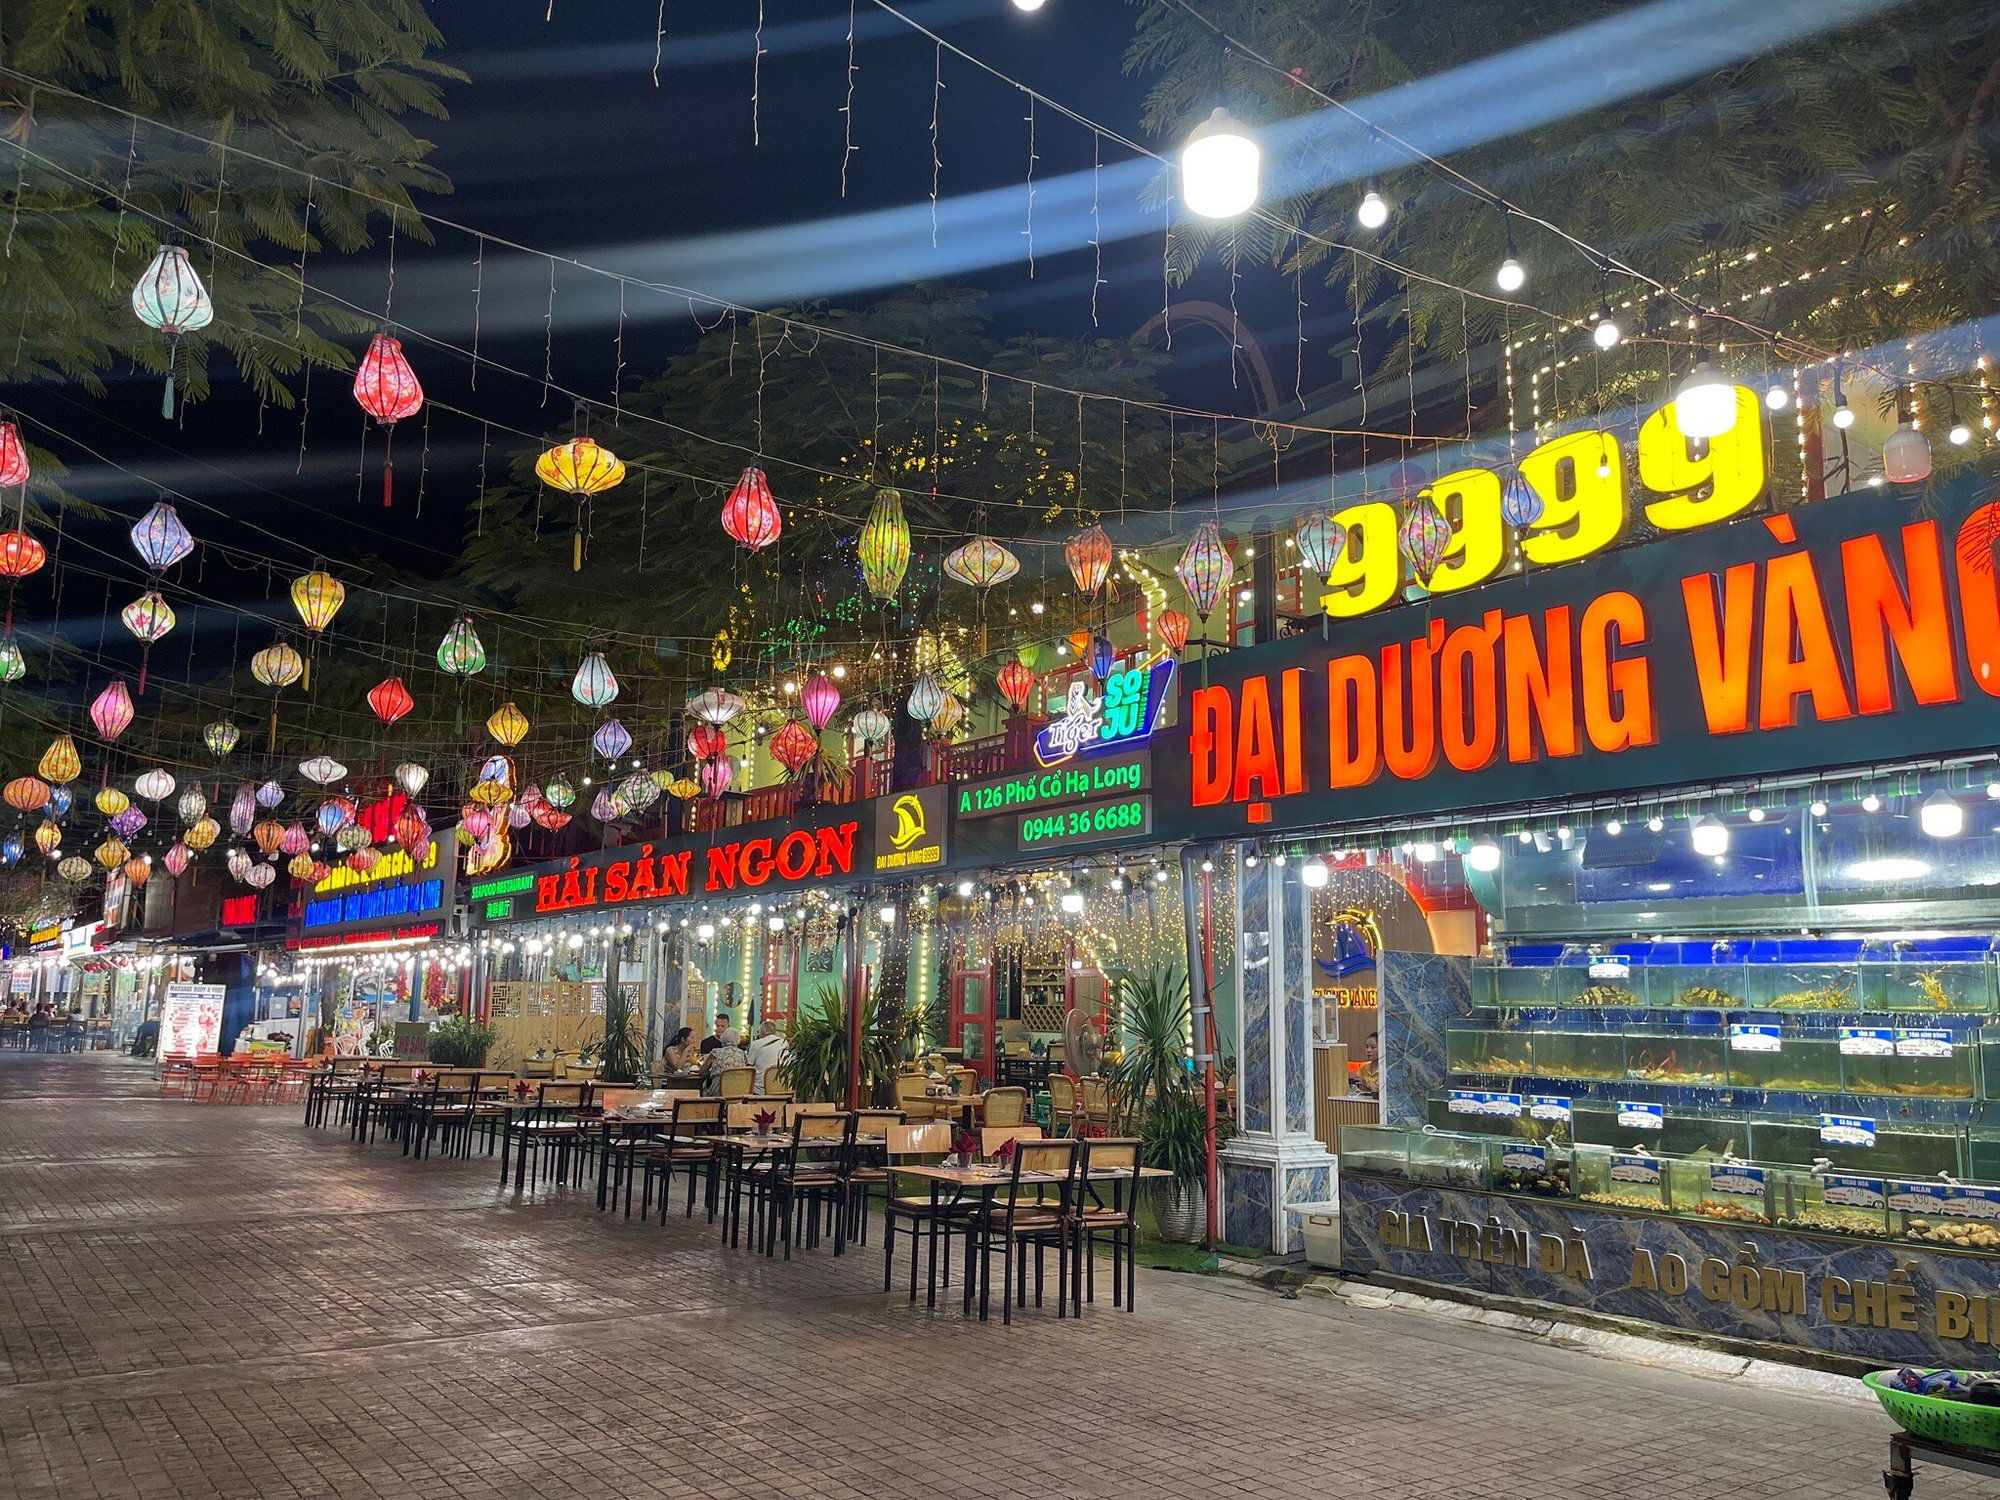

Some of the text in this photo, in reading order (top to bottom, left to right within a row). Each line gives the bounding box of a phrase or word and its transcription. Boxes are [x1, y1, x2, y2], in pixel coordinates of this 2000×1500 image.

[1319, 383, 1766, 618] 9999
[1048, 712, 1103, 755] Tiger
[1100, 702, 1139, 740] JU
[1189, 666, 1304, 824] ĐẠI
[1328, 590, 1654, 791] DƯƠNG
[960, 763, 1141, 813] A 126 Phố Cổ Hạ Long
[1022, 802, 1142, 842] 0944 36 6688
[535, 820, 858, 913] HẢI SẢN NGON
[1378, 1205, 1434, 1252] GIÁ
[1438, 1215, 1531, 1269] TRÊN
[1700, 1241, 1807, 1316] GỒM
[1819, 1260, 1919, 1333] CHẾ
[1935, 1289, 2000, 1350] BI
